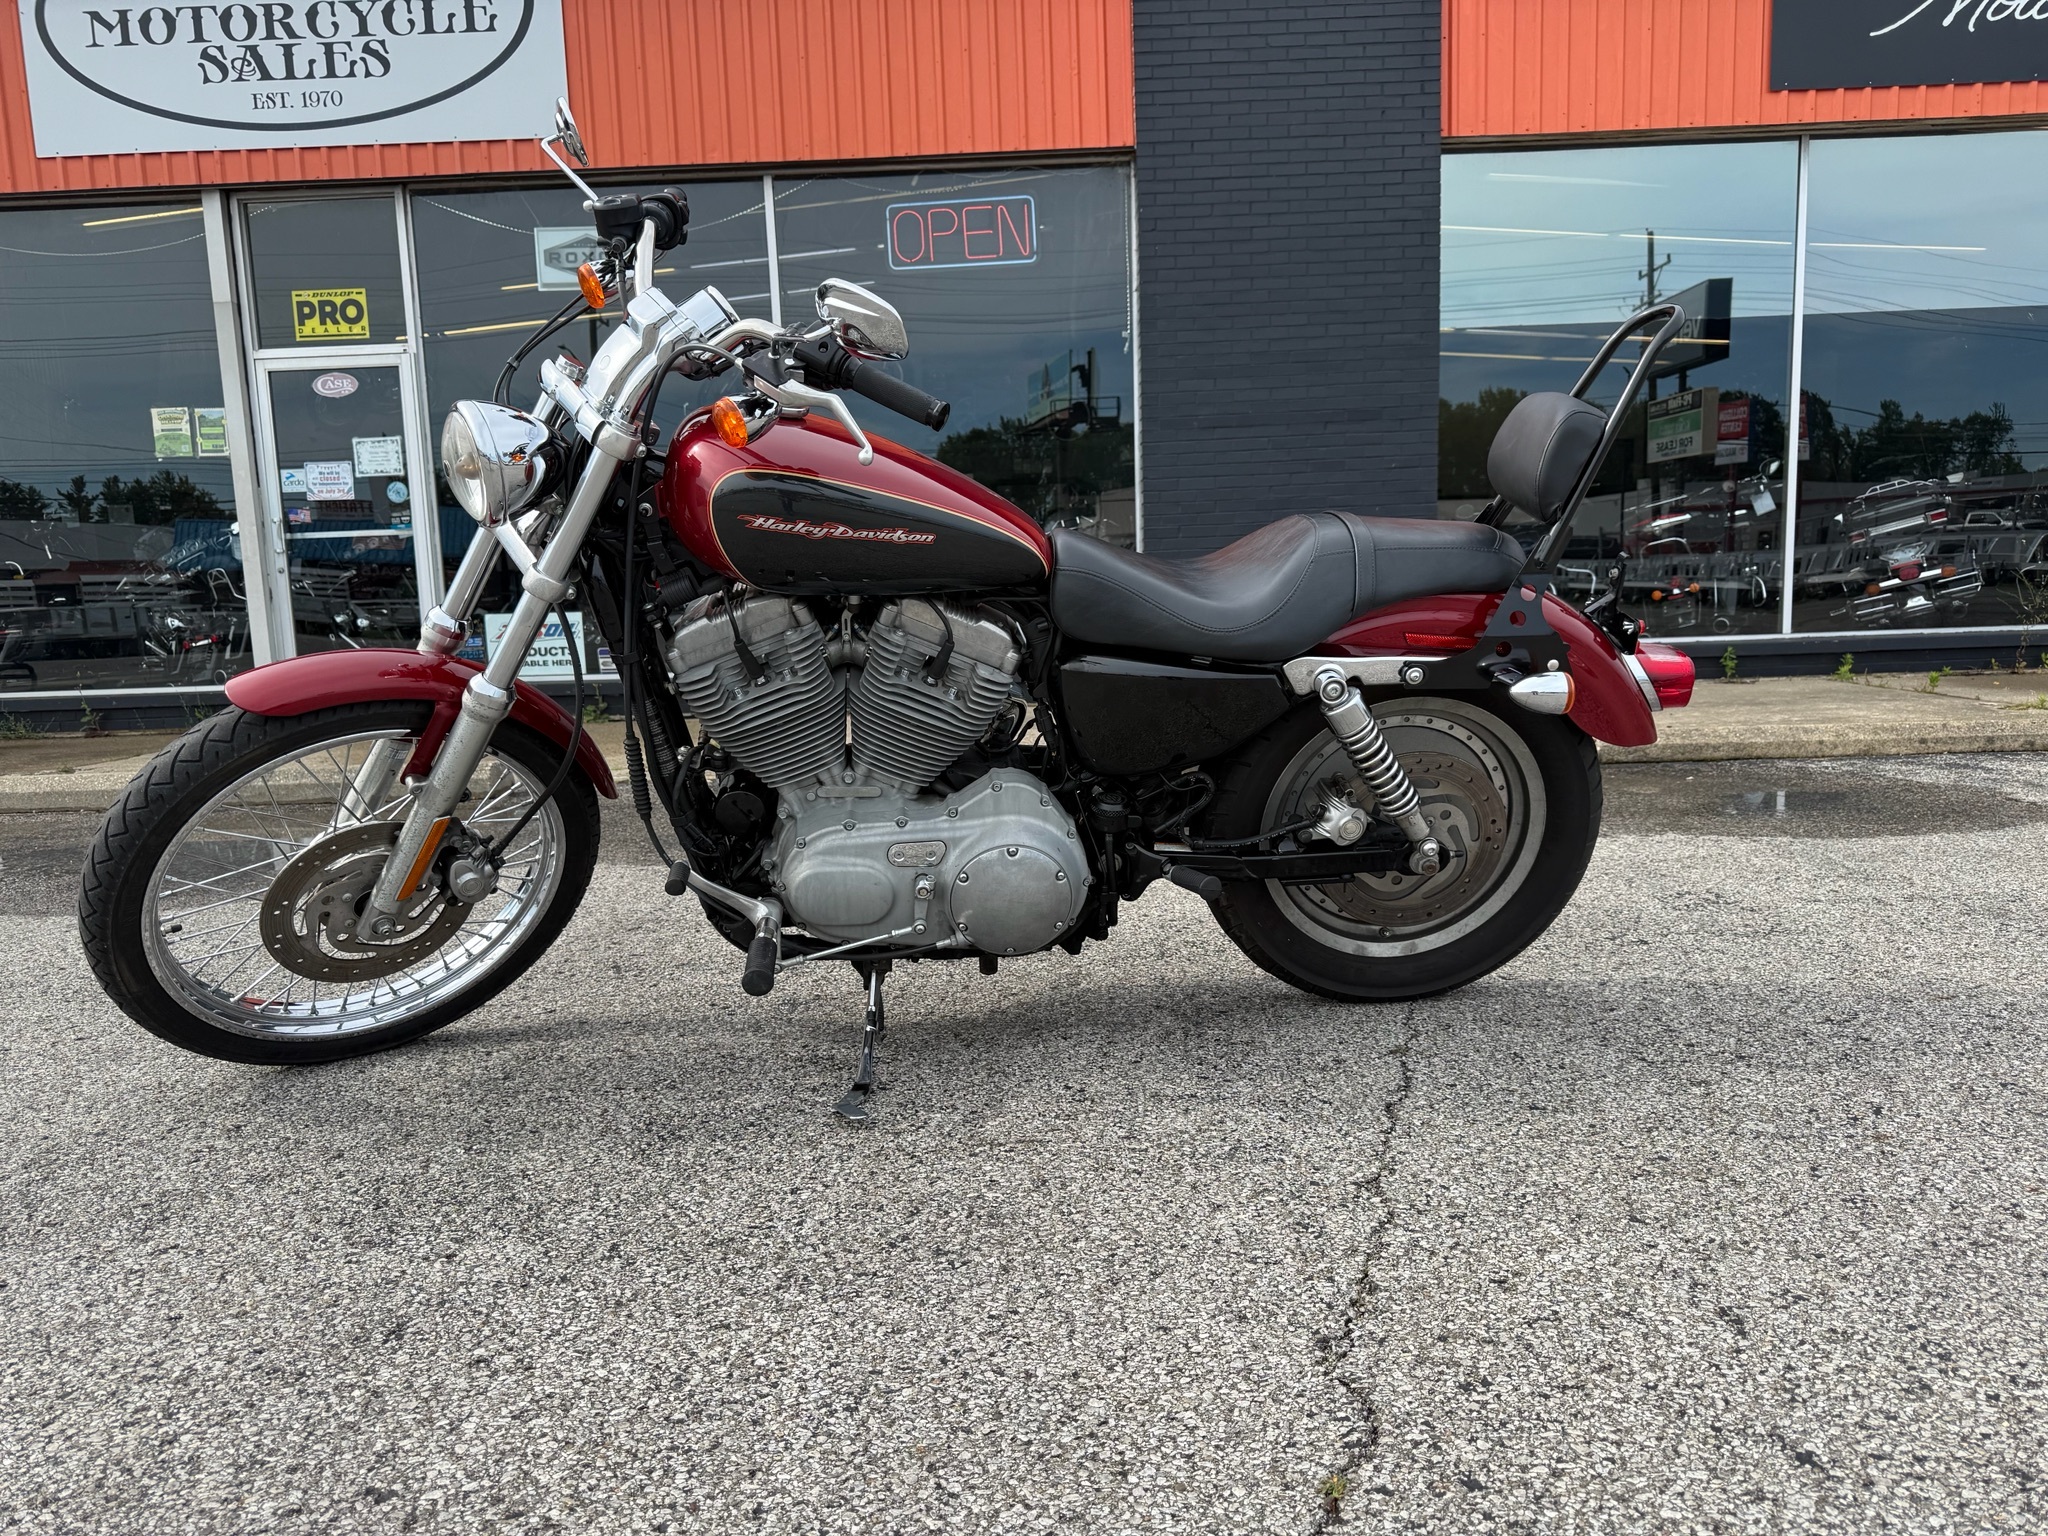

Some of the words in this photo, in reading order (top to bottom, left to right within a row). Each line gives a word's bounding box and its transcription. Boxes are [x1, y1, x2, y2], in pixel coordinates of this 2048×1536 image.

[83, 0, 498, 48] MOTORCYCLE
[198, 38, 391, 85] SALES
[251, 92, 295, 111] EST.
[300, 90, 344, 108] 1970
[892, 203, 1030, 263] OPEN
[295, 298, 365, 327] PRO
[298, 326, 367, 334] DEALER
[316, 376, 354, 394] CASE
[283, 479, 305, 487] cardo
[742, 515, 936, 545] Harley-Davidson
